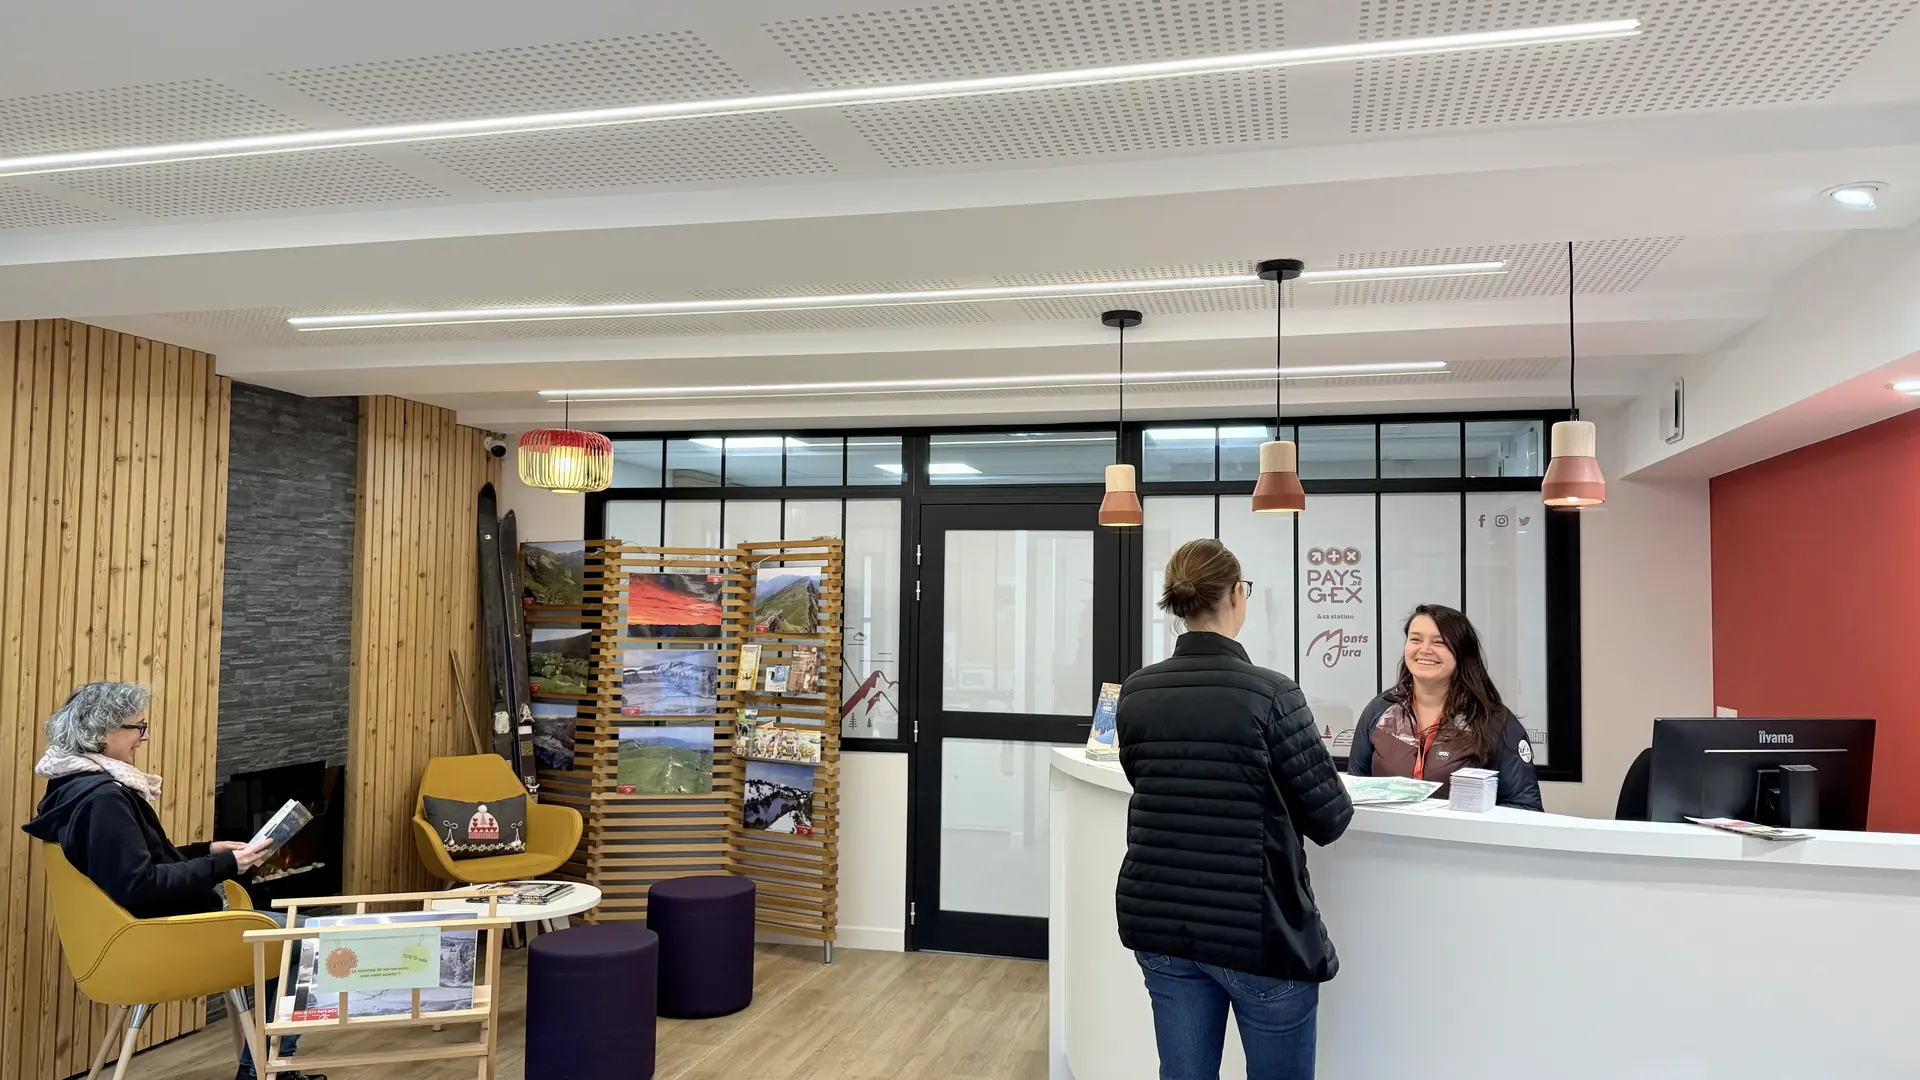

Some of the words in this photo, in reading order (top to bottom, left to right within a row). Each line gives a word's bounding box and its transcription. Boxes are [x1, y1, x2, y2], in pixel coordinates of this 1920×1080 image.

[1307, 569, 1362, 586] PAYS
[1307, 587, 1363, 603] GEX
[1305, 628, 1369, 657] Monts
[1758, 730, 1794, 744] iiyama
